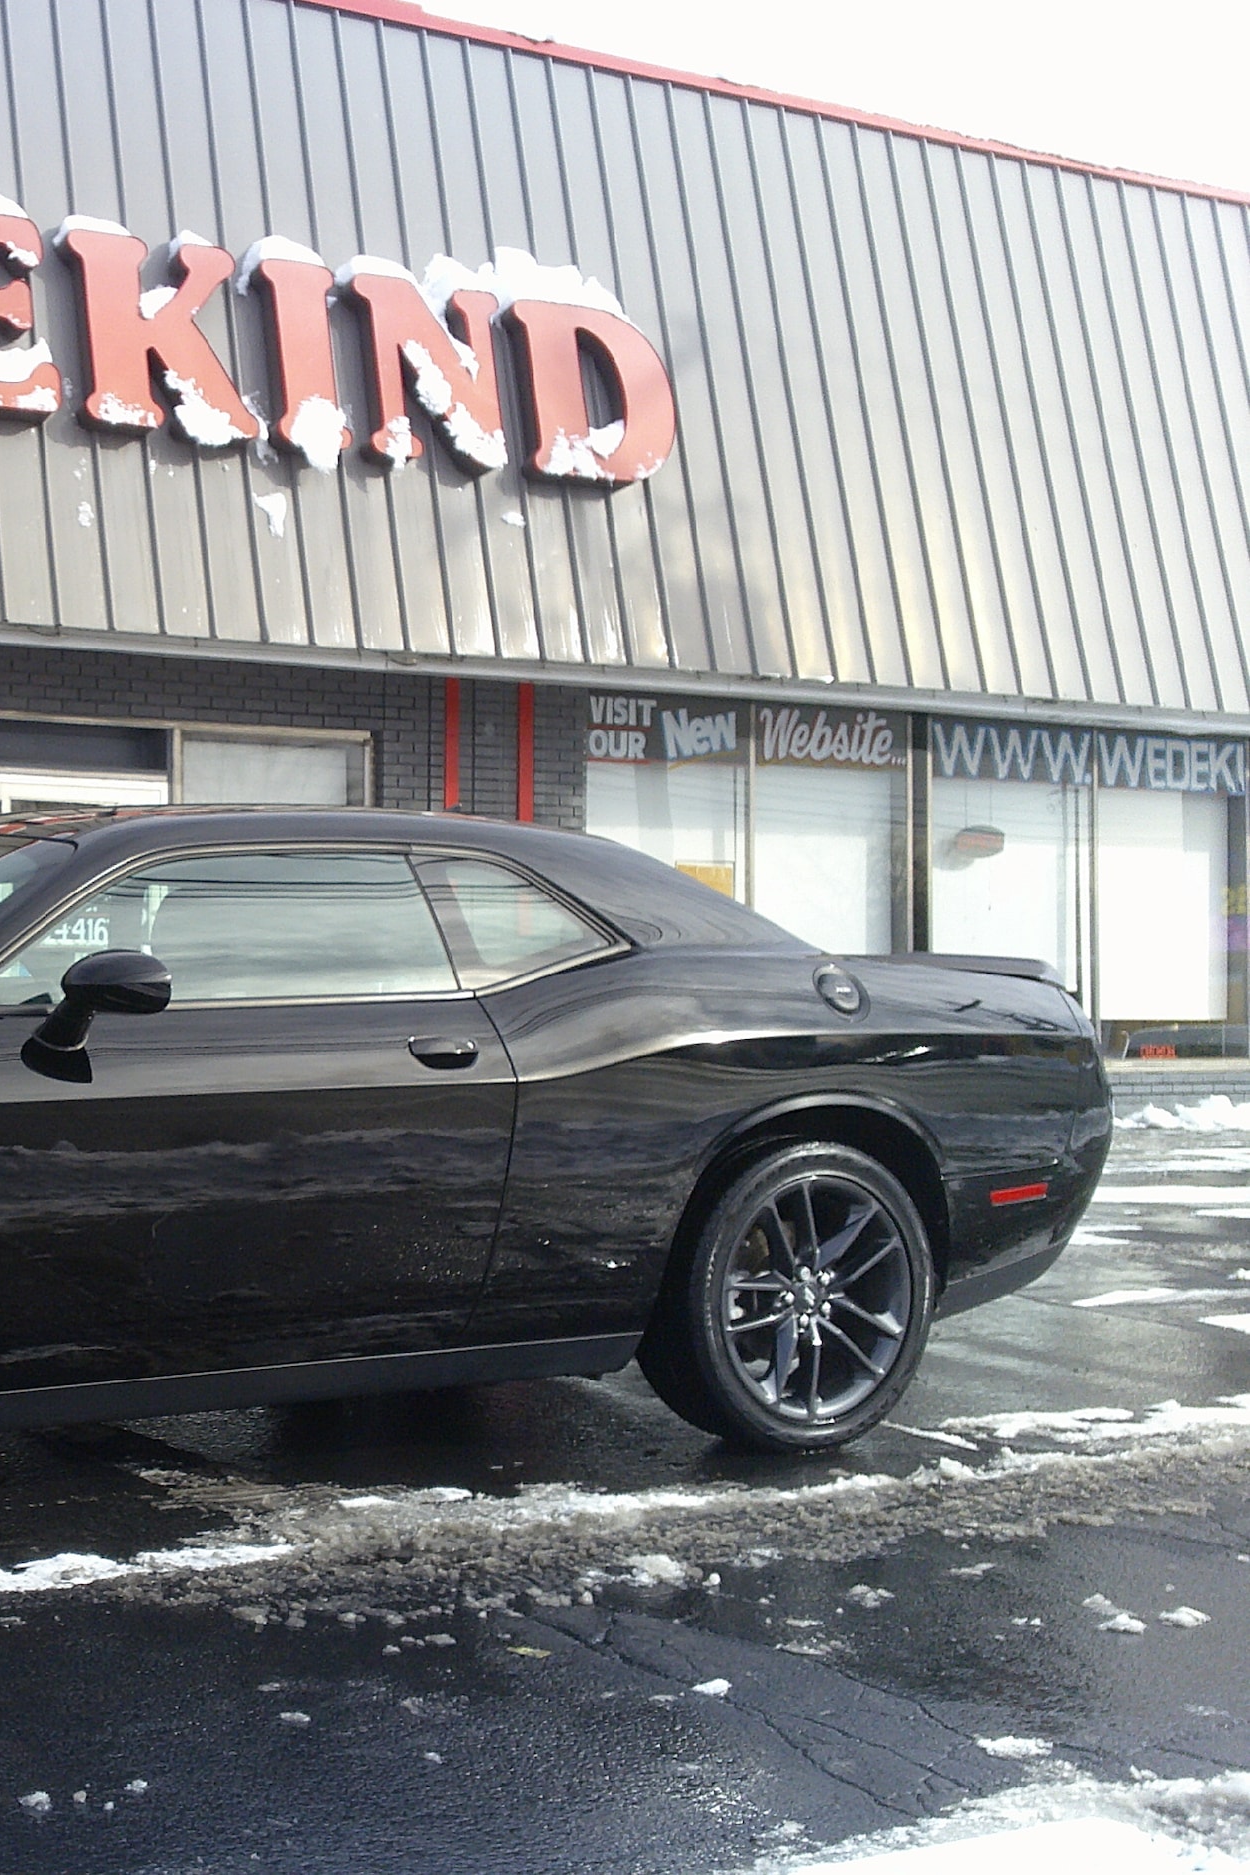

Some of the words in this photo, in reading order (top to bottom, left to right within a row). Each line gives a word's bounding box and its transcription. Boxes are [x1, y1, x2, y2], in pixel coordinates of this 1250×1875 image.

[589, 696, 657, 727] VISIT
[589, 730, 647, 759] OUR
[661, 708, 738, 760] New
